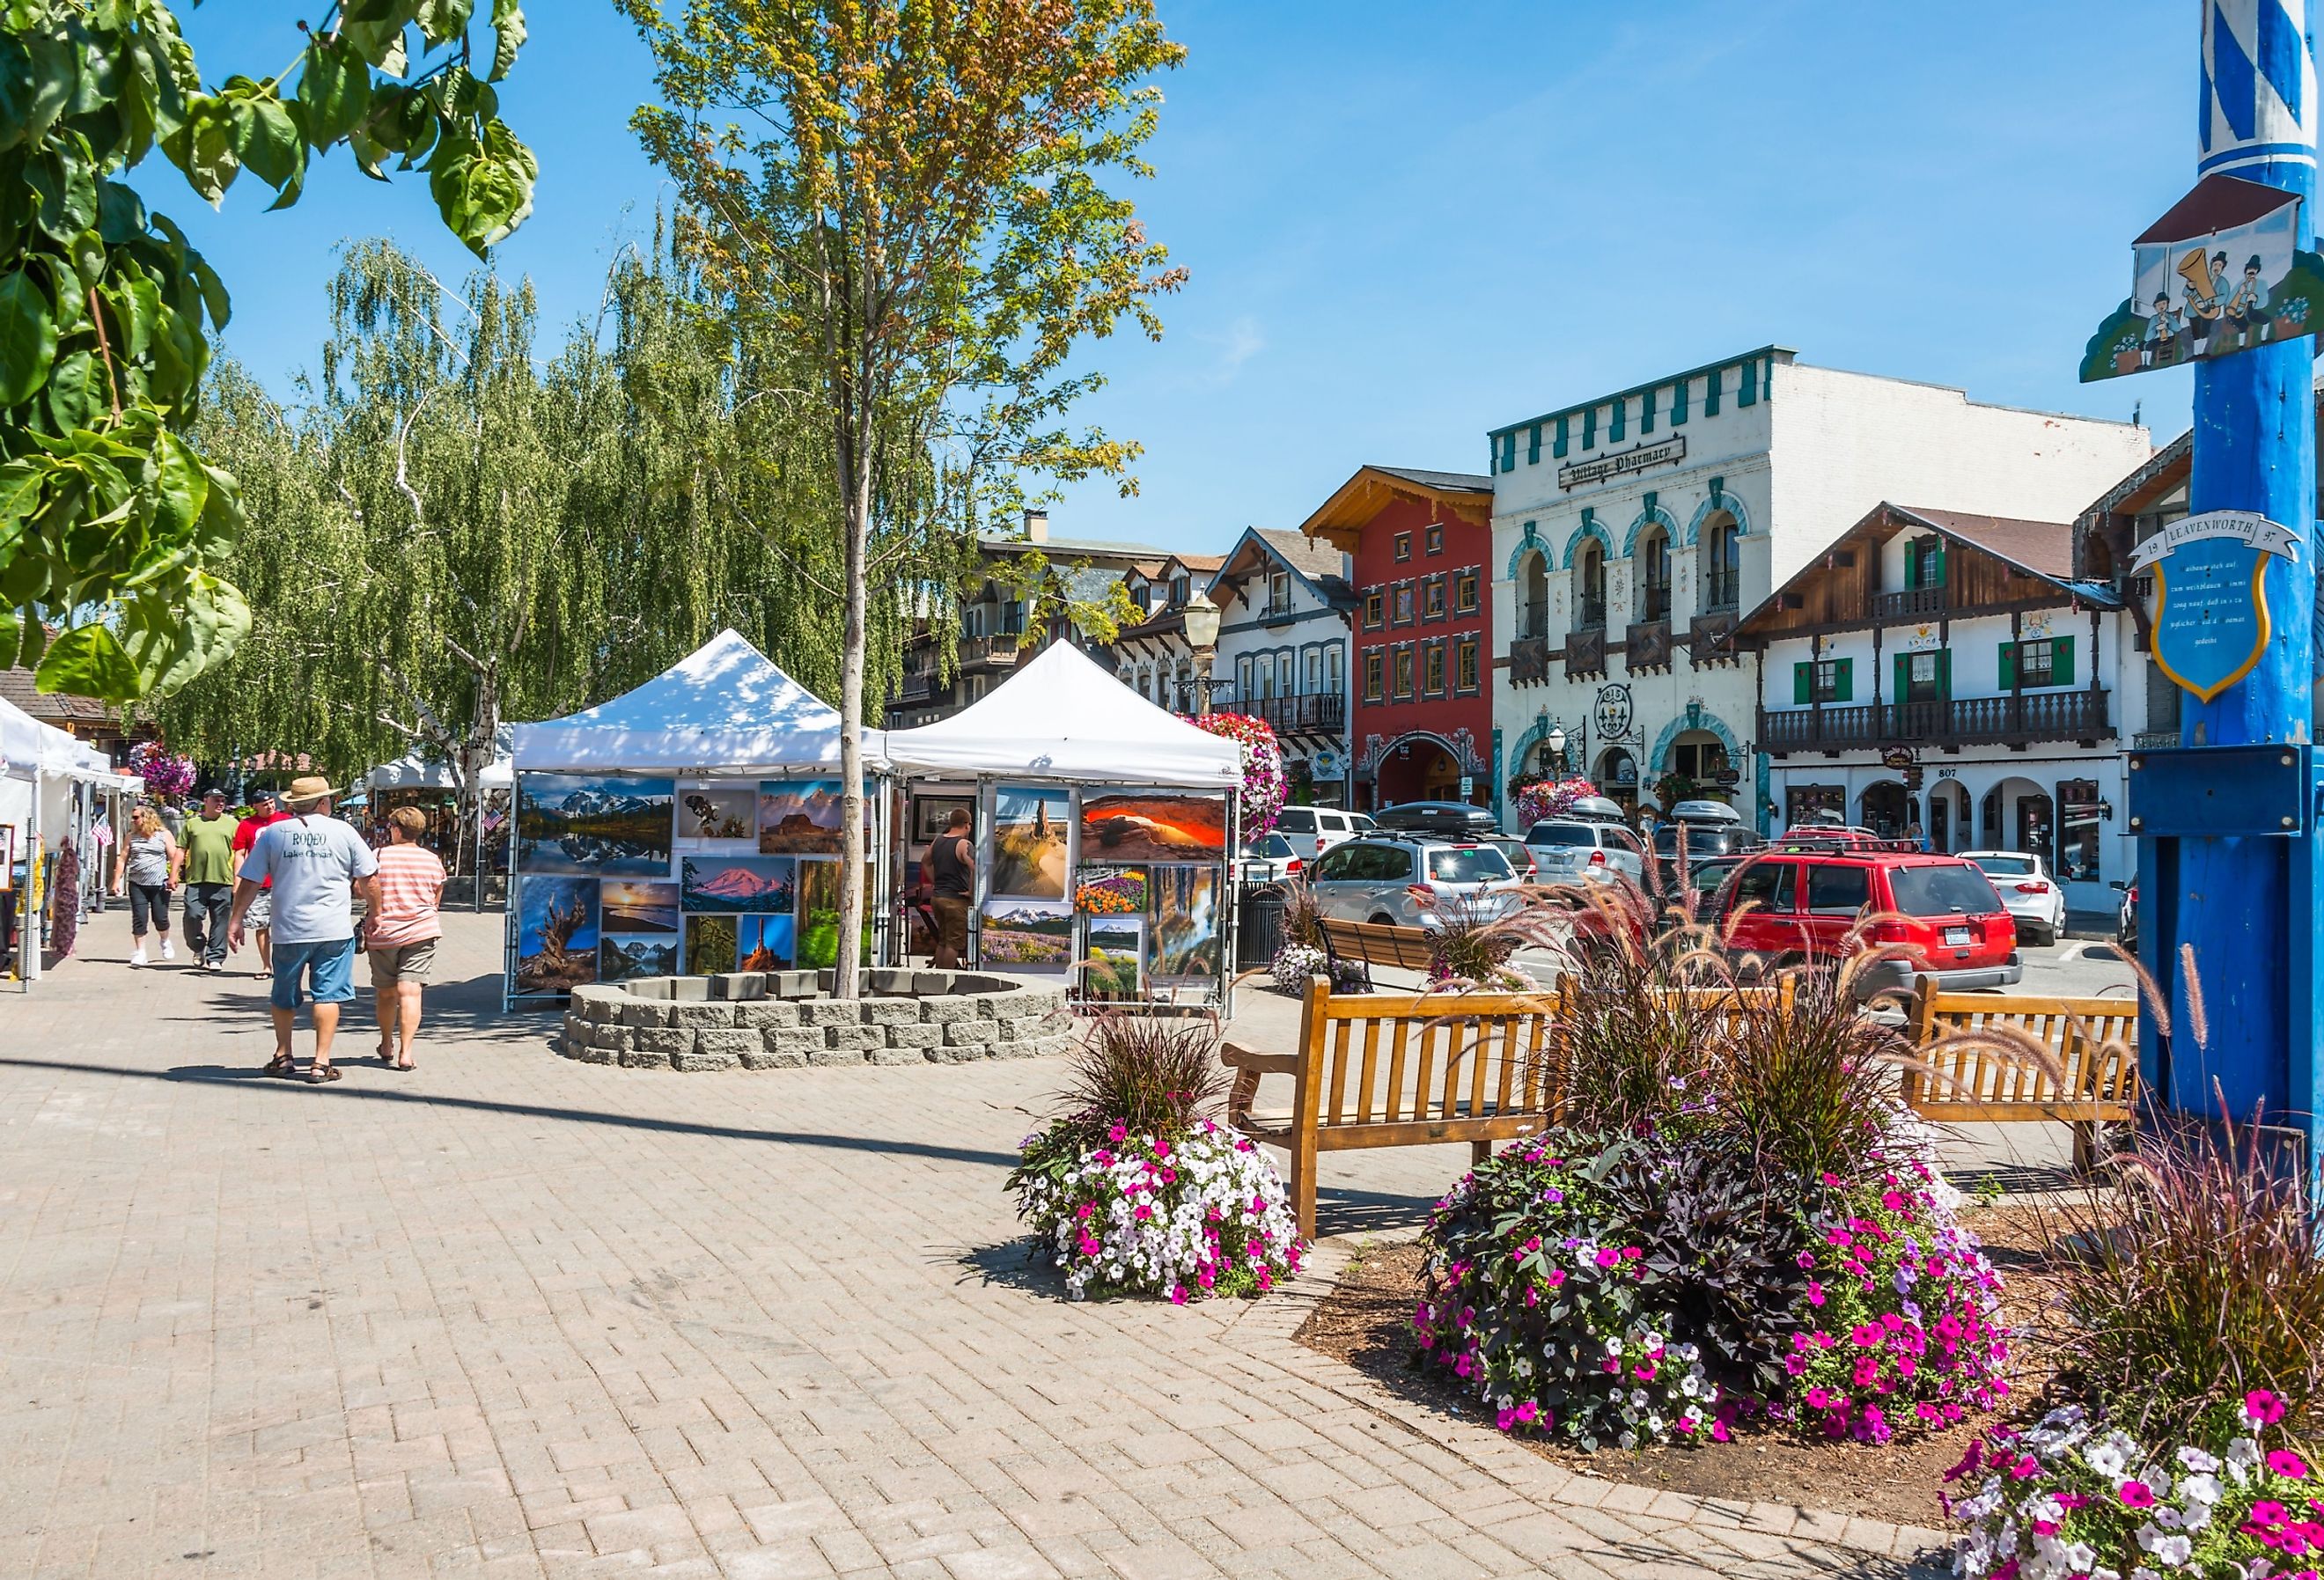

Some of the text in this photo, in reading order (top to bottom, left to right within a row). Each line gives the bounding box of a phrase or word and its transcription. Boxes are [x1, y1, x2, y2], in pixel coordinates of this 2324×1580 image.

[1570, 446, 1671, 481] Village Pharmacy
[2148, 518, 2277, 555] 19 LEAVENWORTH 97
[1605, 688, 1622, 700] 815
[1938, 768, 1957, 778] 807
[292, 832, 327, 847] RODEO
[283, 849, 304, 858] Lake
